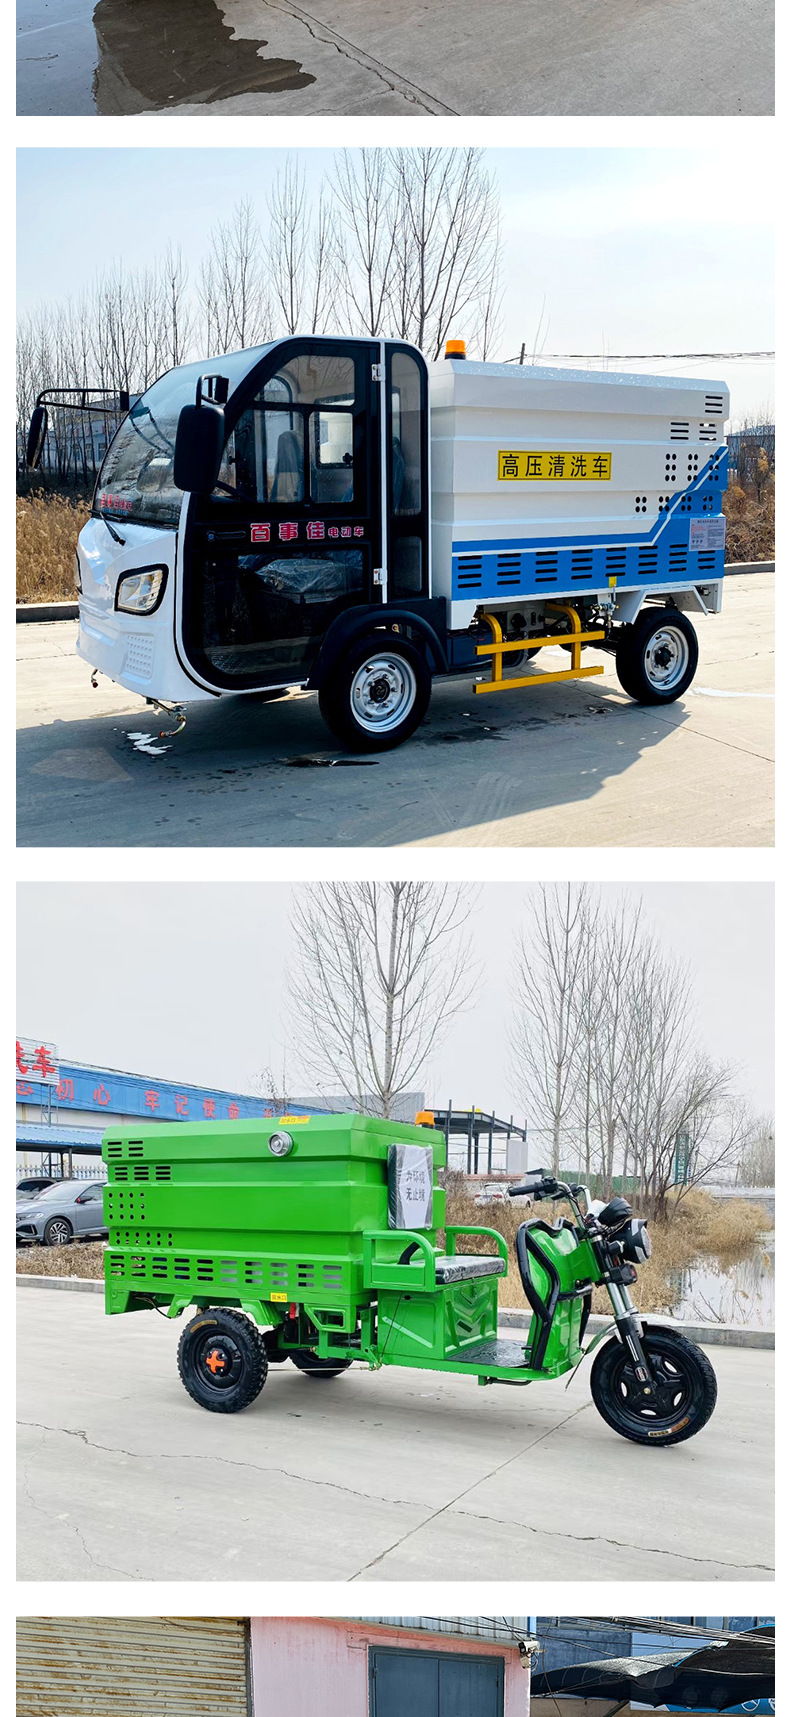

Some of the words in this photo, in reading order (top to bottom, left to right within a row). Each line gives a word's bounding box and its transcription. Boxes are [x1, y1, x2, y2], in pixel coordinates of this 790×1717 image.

[502, 454, 608, 477] 高压清洗车
[250, 521, 364, 542] 百事佳电动车
[144, 1090, 240, 1120] 牢记使命
